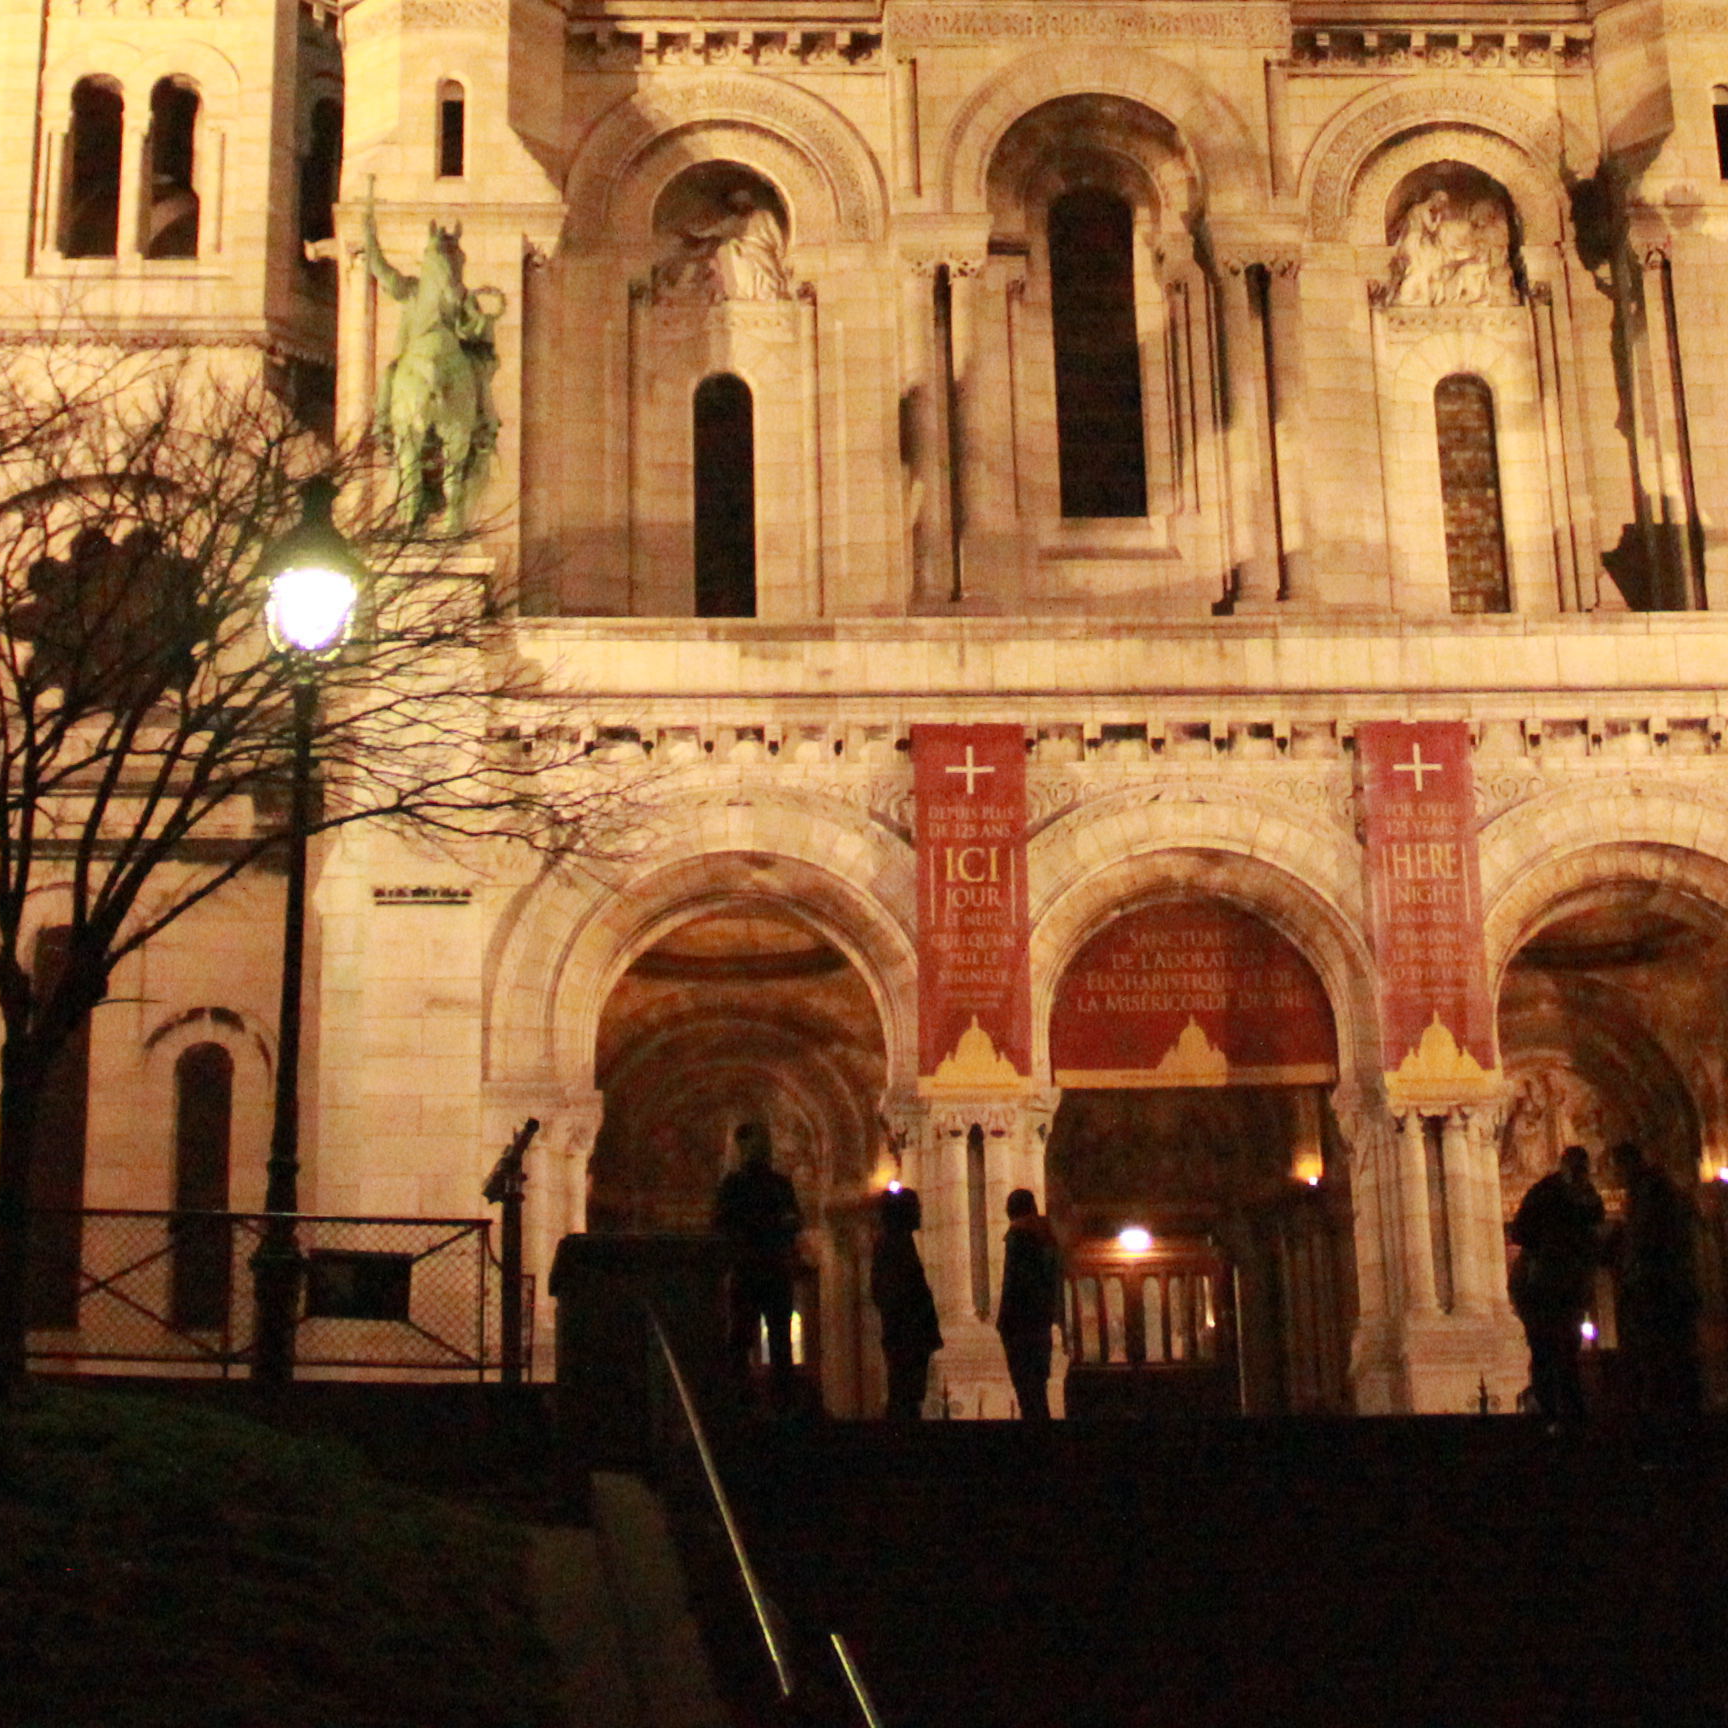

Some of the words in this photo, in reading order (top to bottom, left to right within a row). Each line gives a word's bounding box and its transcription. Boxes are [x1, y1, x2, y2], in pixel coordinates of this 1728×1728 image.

[928, 805, 977, 819] DEPUIS
[981, 805, 1014, 819] PLUS
[1384, 802, 1413, 817] FOR
[1418, 802, 1457, 817] OVER
[928, 822, 949, 838] DE
[954, 822, 977, 838] 125
[979, 822, 1010, 838] ANS
[1385, 820, 1408, 835] 125
[1411, 820, 1457, 835] YEARS
[944, 846, 1000, 882] ICI
[1391, 843, 1458, 879] HERE
[945, 886, 1003, 910] JOUR
[1394, 884, 1460, 904] NIGHT
[1128, 929, 1244, 949] SANCTUAIRE
[1112, 952, 1135, 970] DE
[1085, 970, 1235, 992] EUCHARISTIQUE
[1270, 970, 1293, 989] DE
[1077, 994, 1100, 1013] LA
[1105, 991, 1232, 1013] MISÉRICORDE
[1238, 990, 1306, 1010] DIVINE
